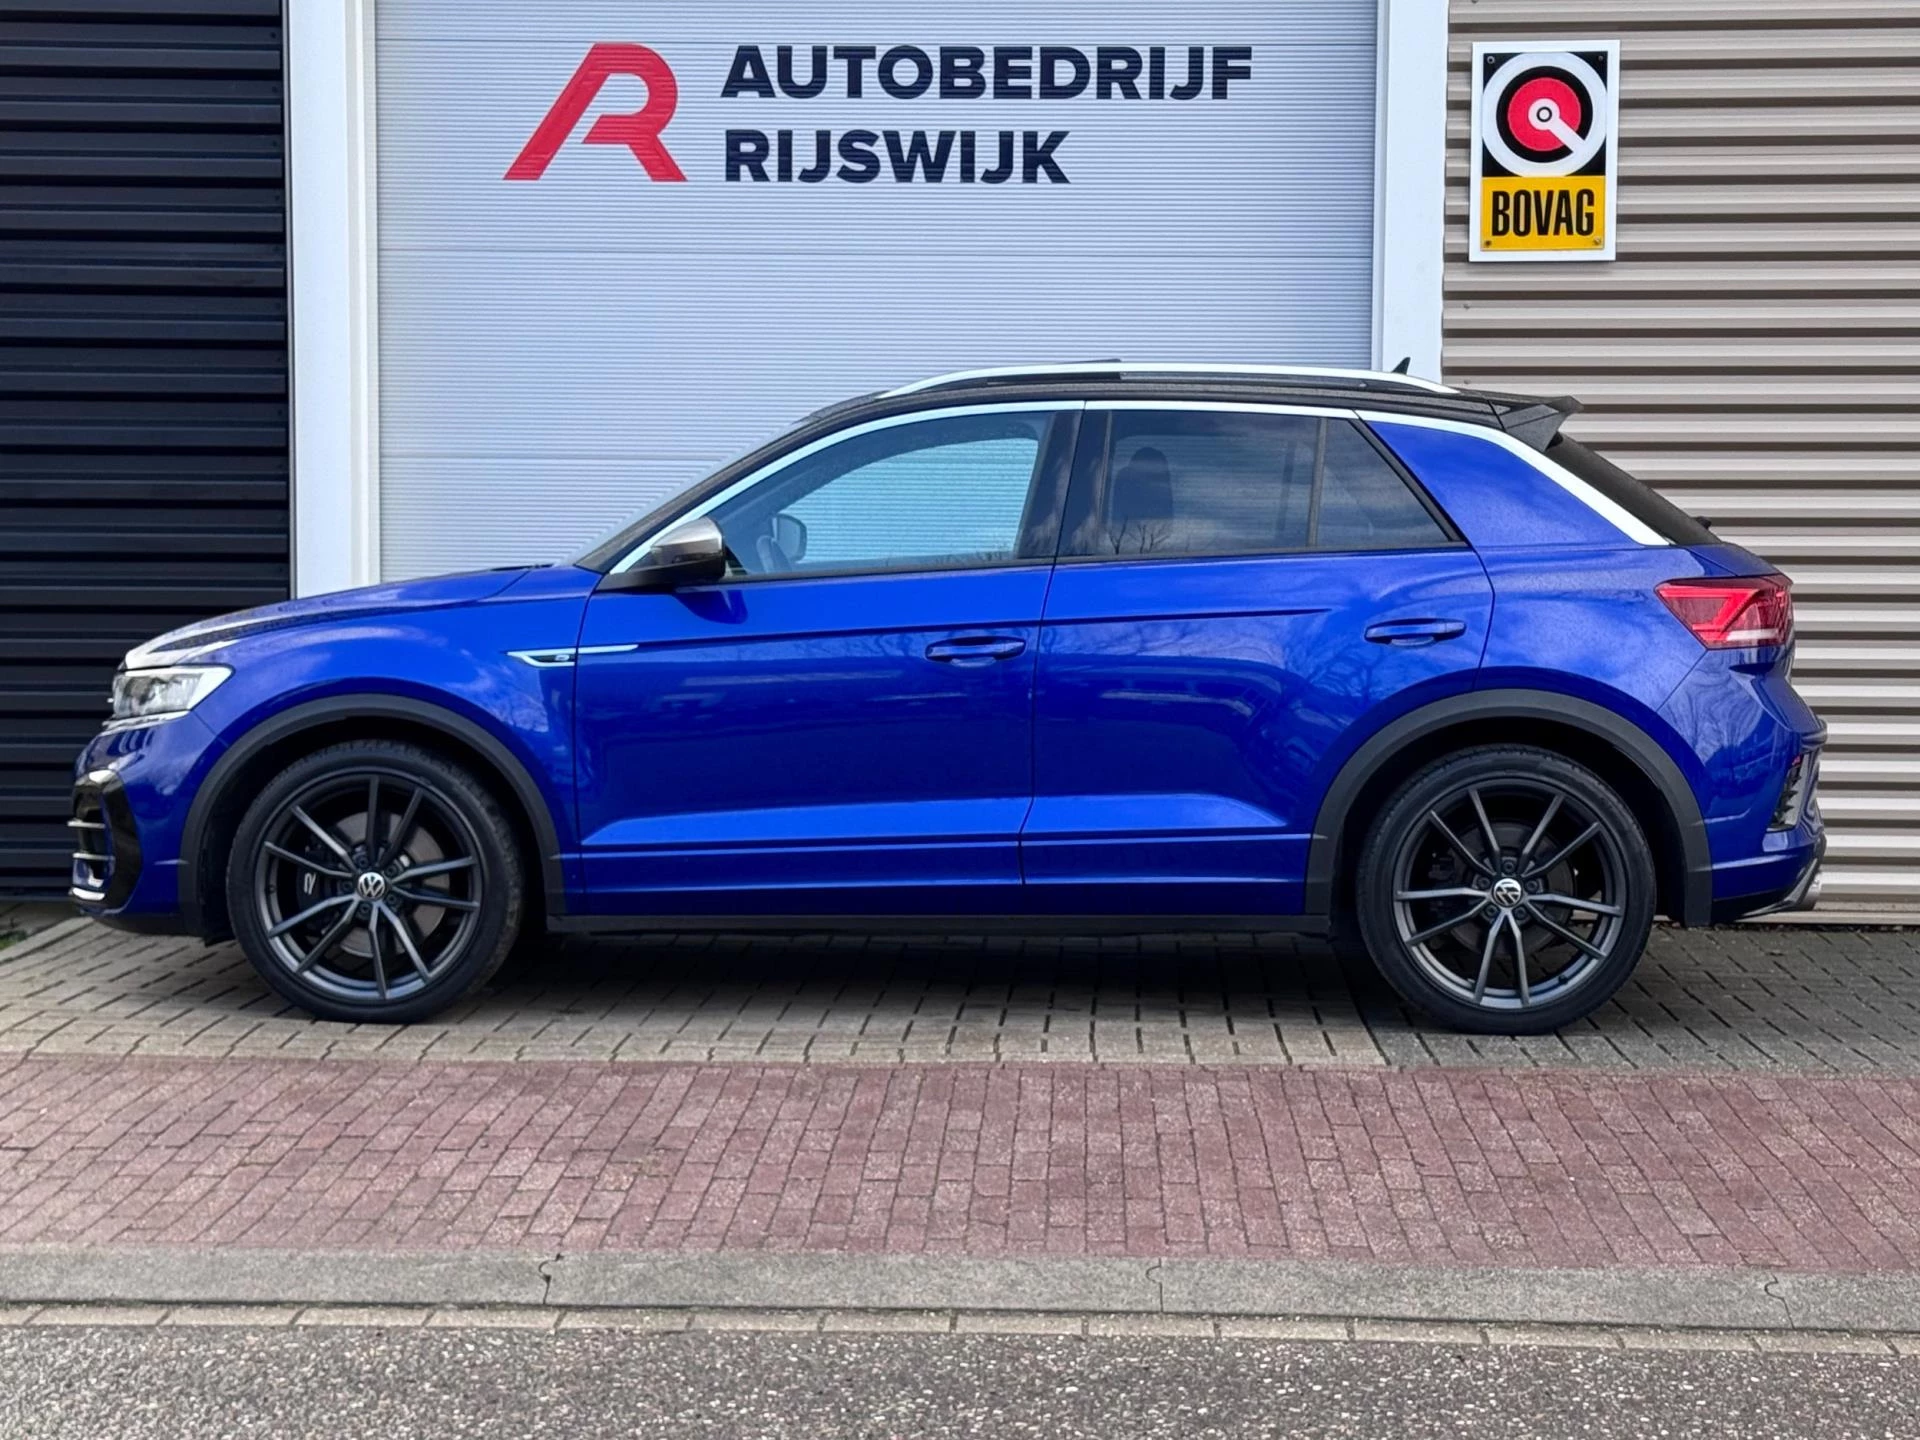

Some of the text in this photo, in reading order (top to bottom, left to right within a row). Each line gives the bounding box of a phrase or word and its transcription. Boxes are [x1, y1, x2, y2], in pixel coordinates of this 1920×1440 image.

[721, 44, 1252, 101] AUTOBEDRIJF
[726, 129, 1070, 184] RIJSWIJK
[1491, 188, 1595, 237] BOVAG
